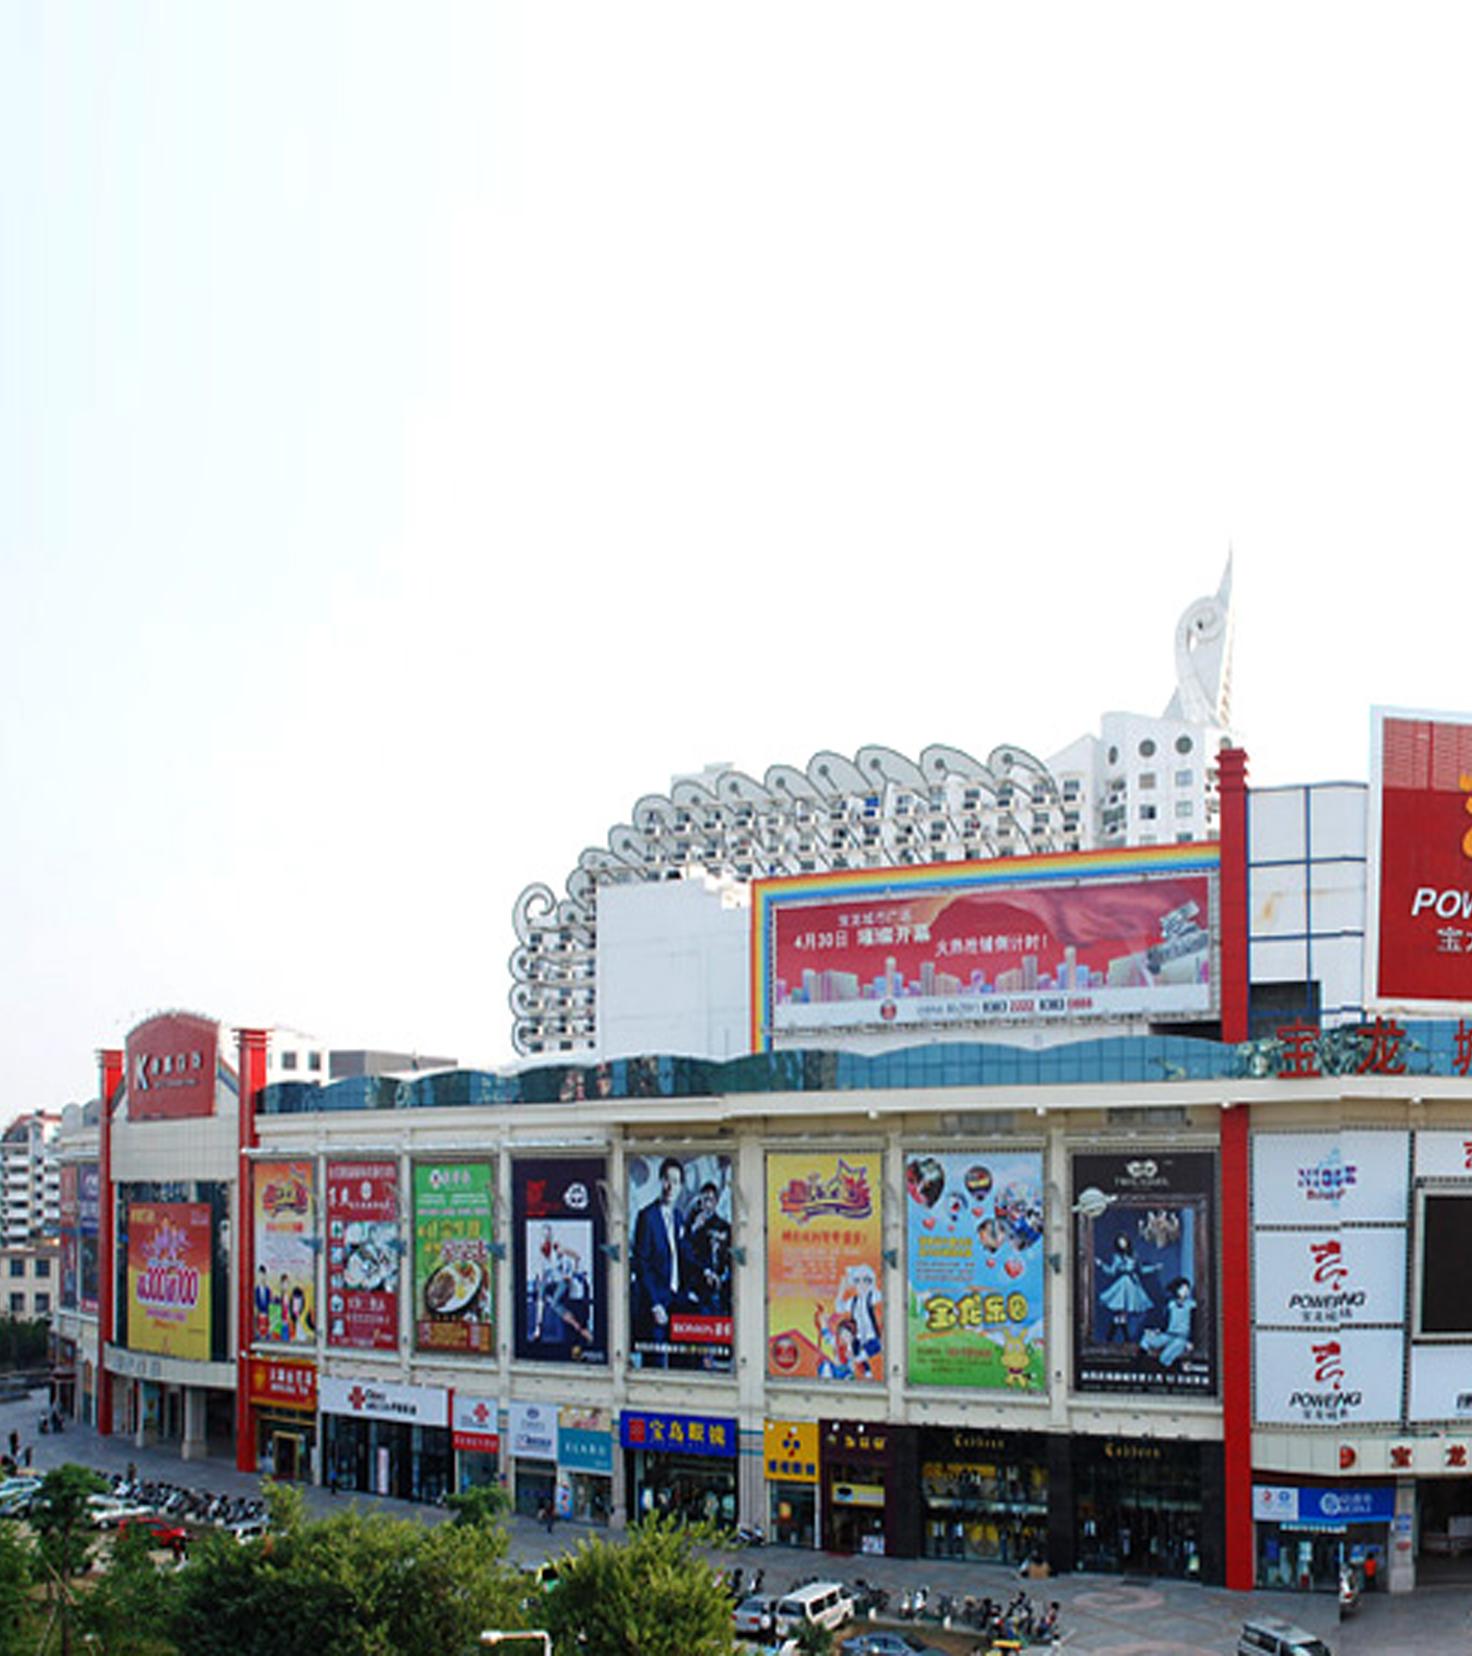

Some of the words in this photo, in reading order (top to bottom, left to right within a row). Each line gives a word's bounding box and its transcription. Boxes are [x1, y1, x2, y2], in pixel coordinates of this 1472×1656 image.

[794, 931, 848, 950] 4月30日
[925, 1291, 1028, 1331] 宝龙乐园
[649, 1420, 726, 1446] 宝岛眼镜
